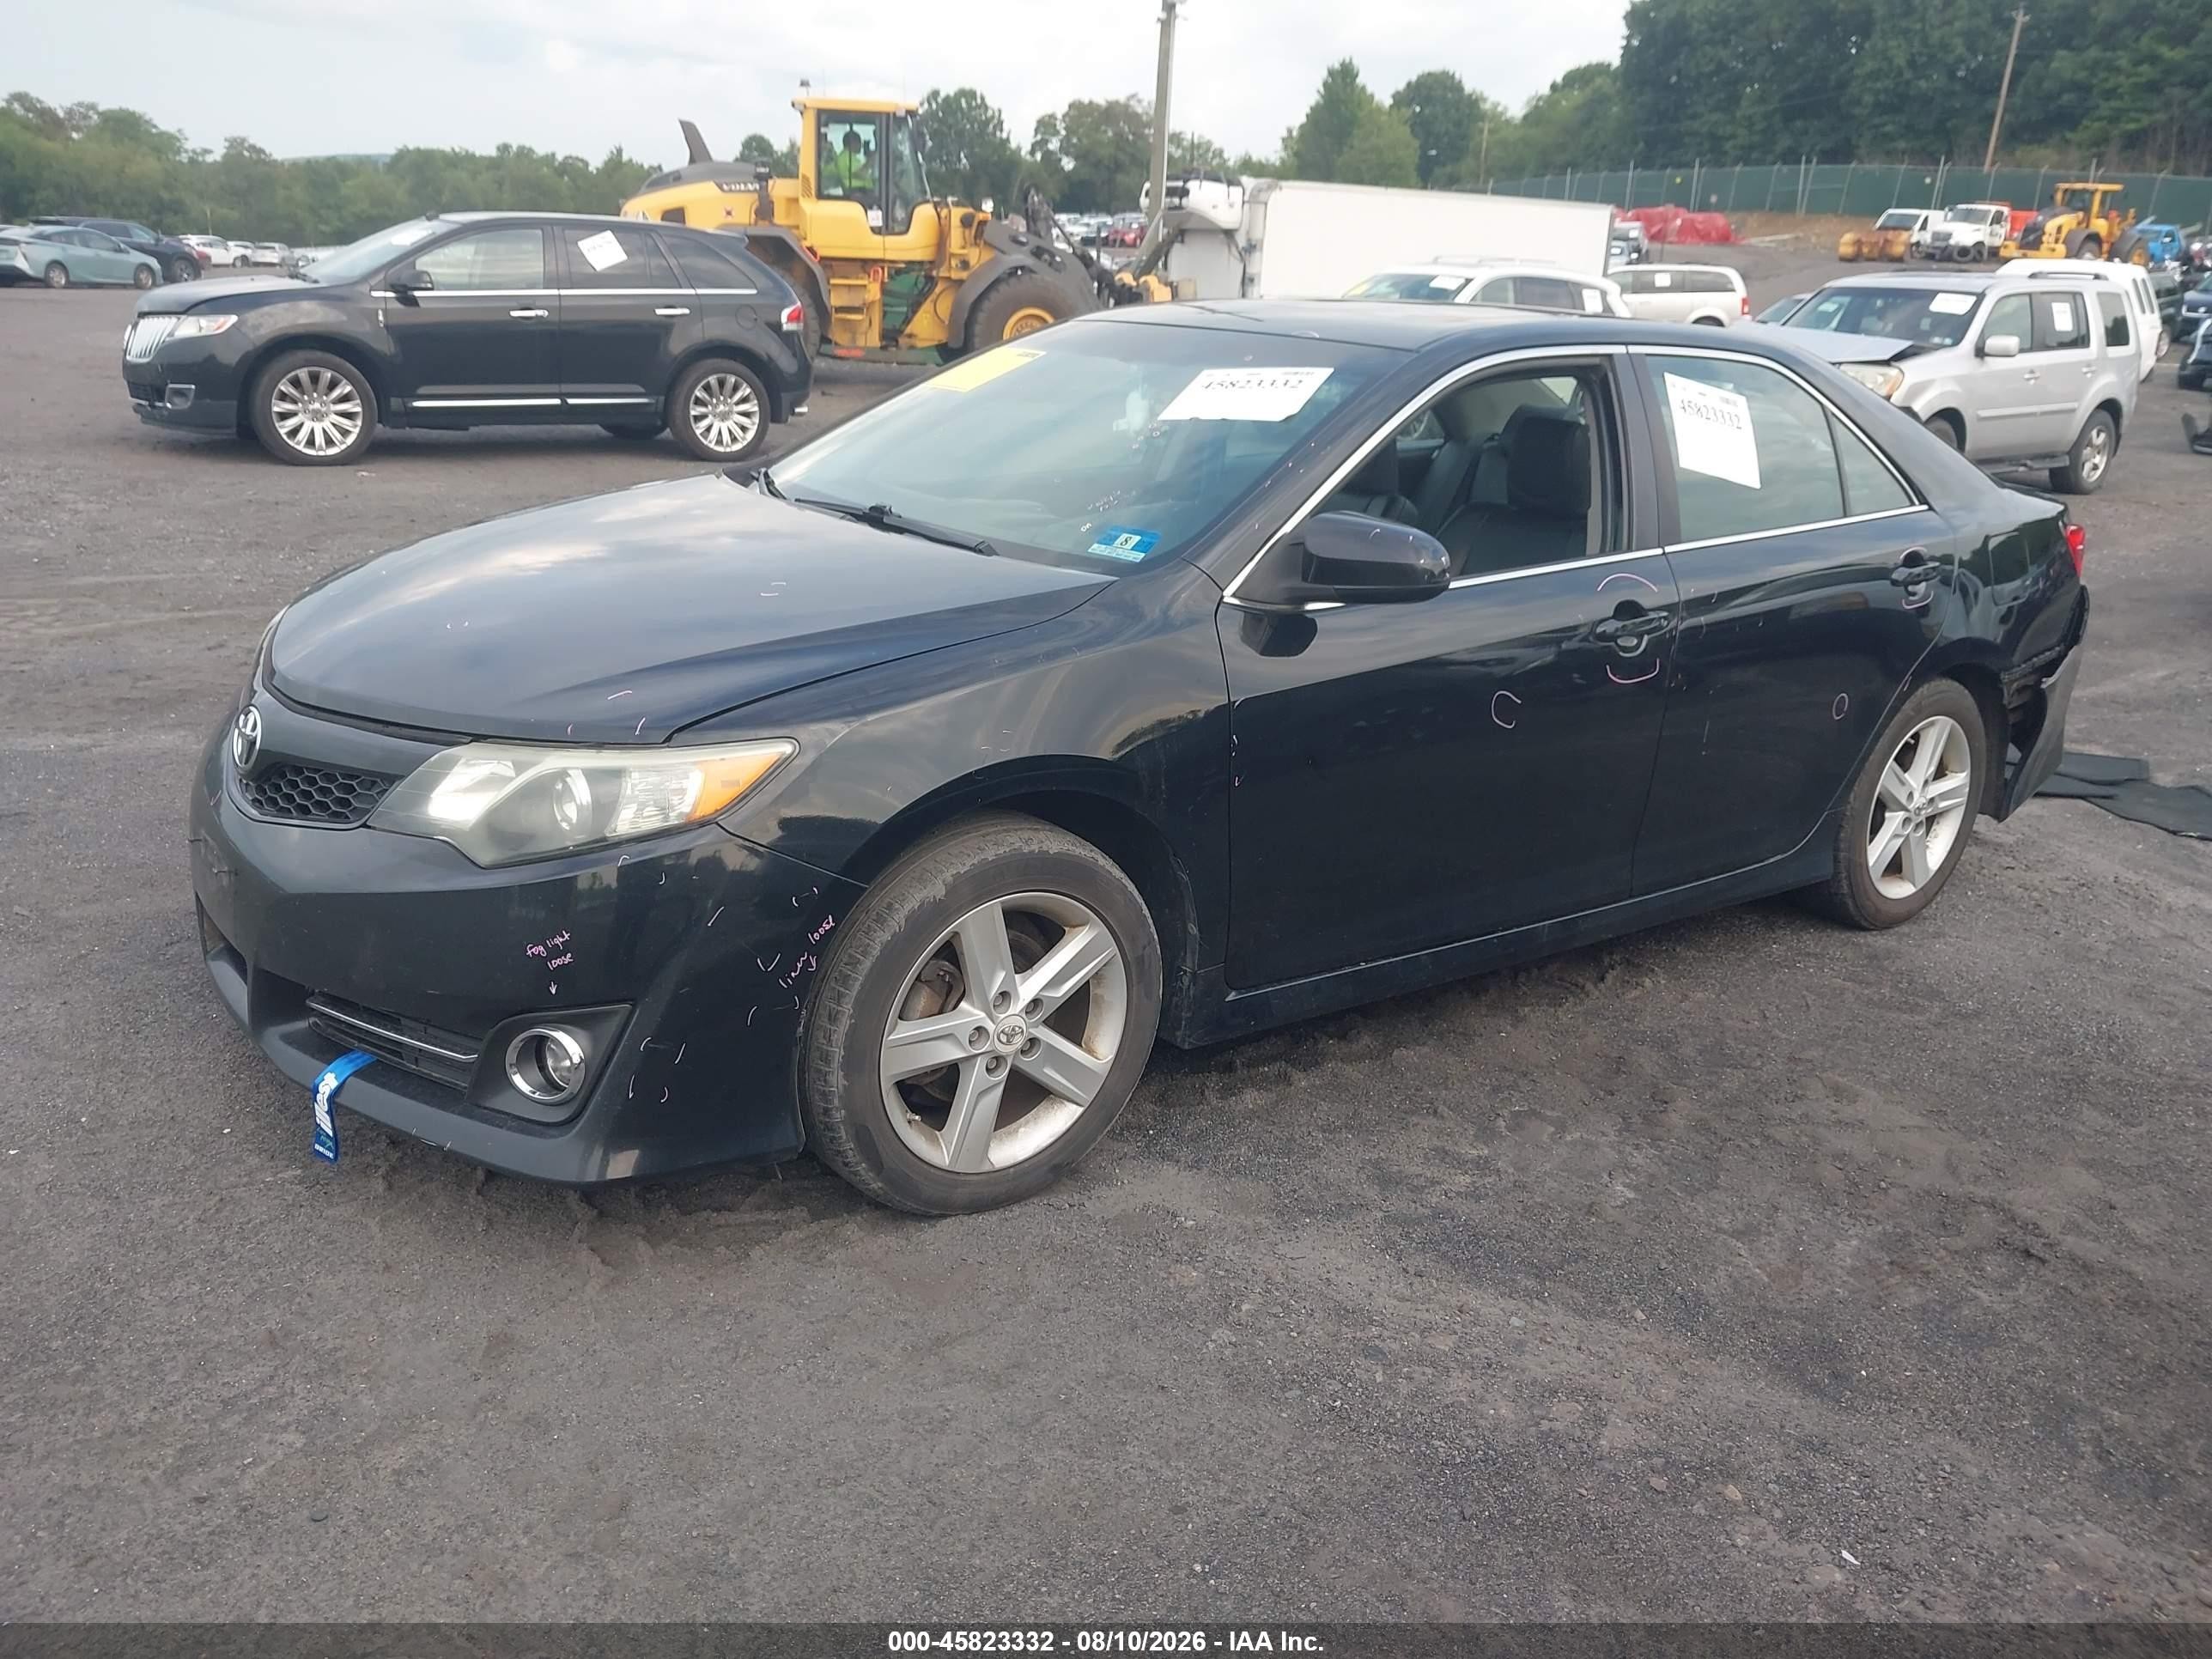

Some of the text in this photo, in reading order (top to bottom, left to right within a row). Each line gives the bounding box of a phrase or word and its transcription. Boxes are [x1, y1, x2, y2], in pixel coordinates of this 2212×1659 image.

[1201, 379, 1304, 390] 45823332
[1680, 398, 1742, 429] 45823332
[807, 914, 836, 945] loose
[526, 930, 571, 958] fog light
[547, 952, 574, 971] loose
